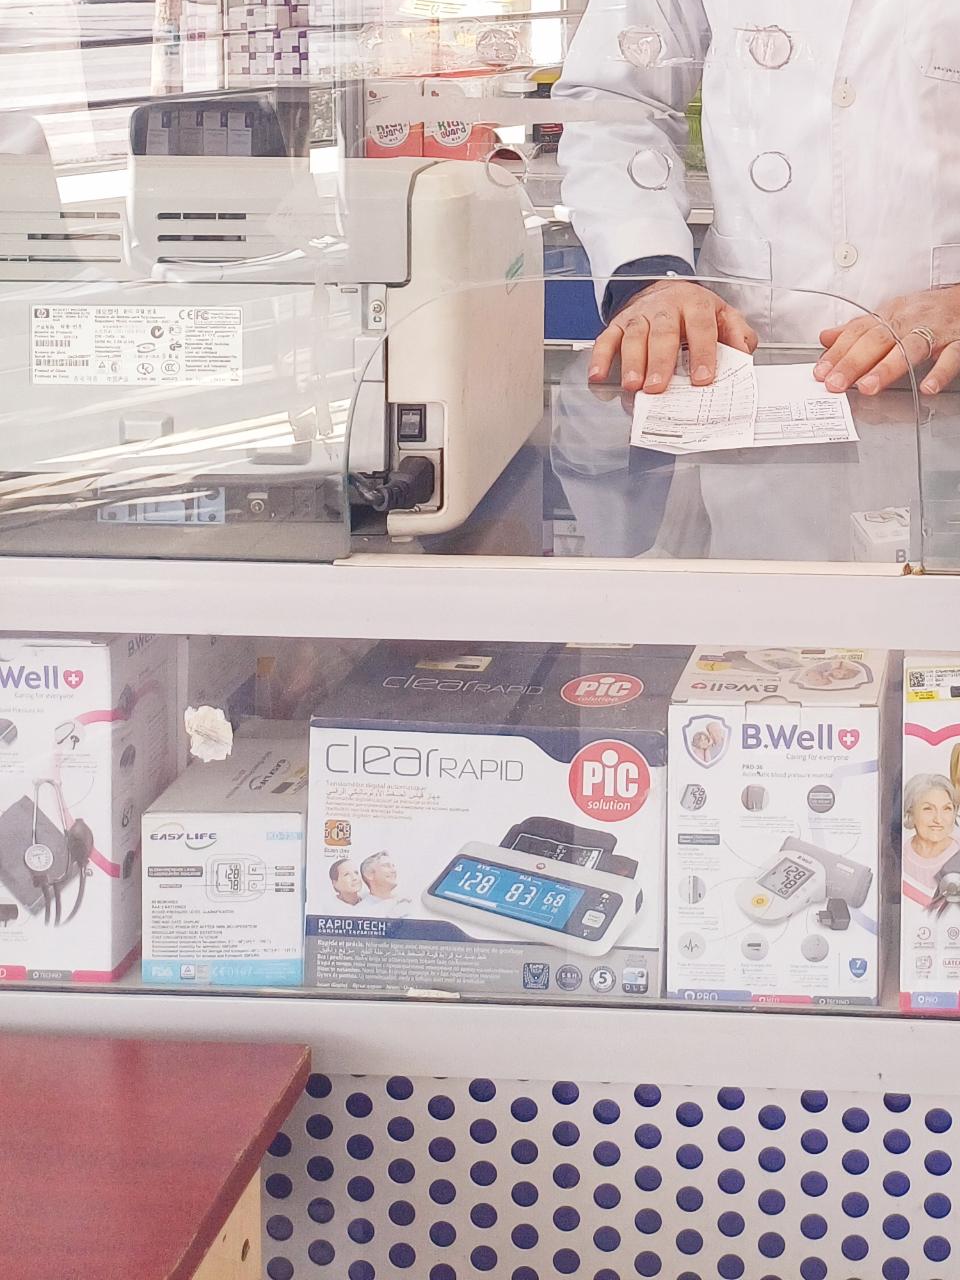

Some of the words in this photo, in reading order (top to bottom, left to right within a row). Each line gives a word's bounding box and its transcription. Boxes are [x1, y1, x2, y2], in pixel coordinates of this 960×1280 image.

[740, 722, 833, 750] B.Well
[580, 747, 641, 797] PiC
[586, 797, 632, 812] solution
[150, 832, 185, 841] EASY
[186, 832, 218, 841] LIFE
[224, 868, 241, 880] 128
[458, 870, 497, 895] 128
[504, 882, 539, 907] 83
[543, 891, 567, 908] 68
[317, 918, 353, 930] RAPID
[356, 919, 387, 932] TECH
[598, 971, 608, 985] 5
